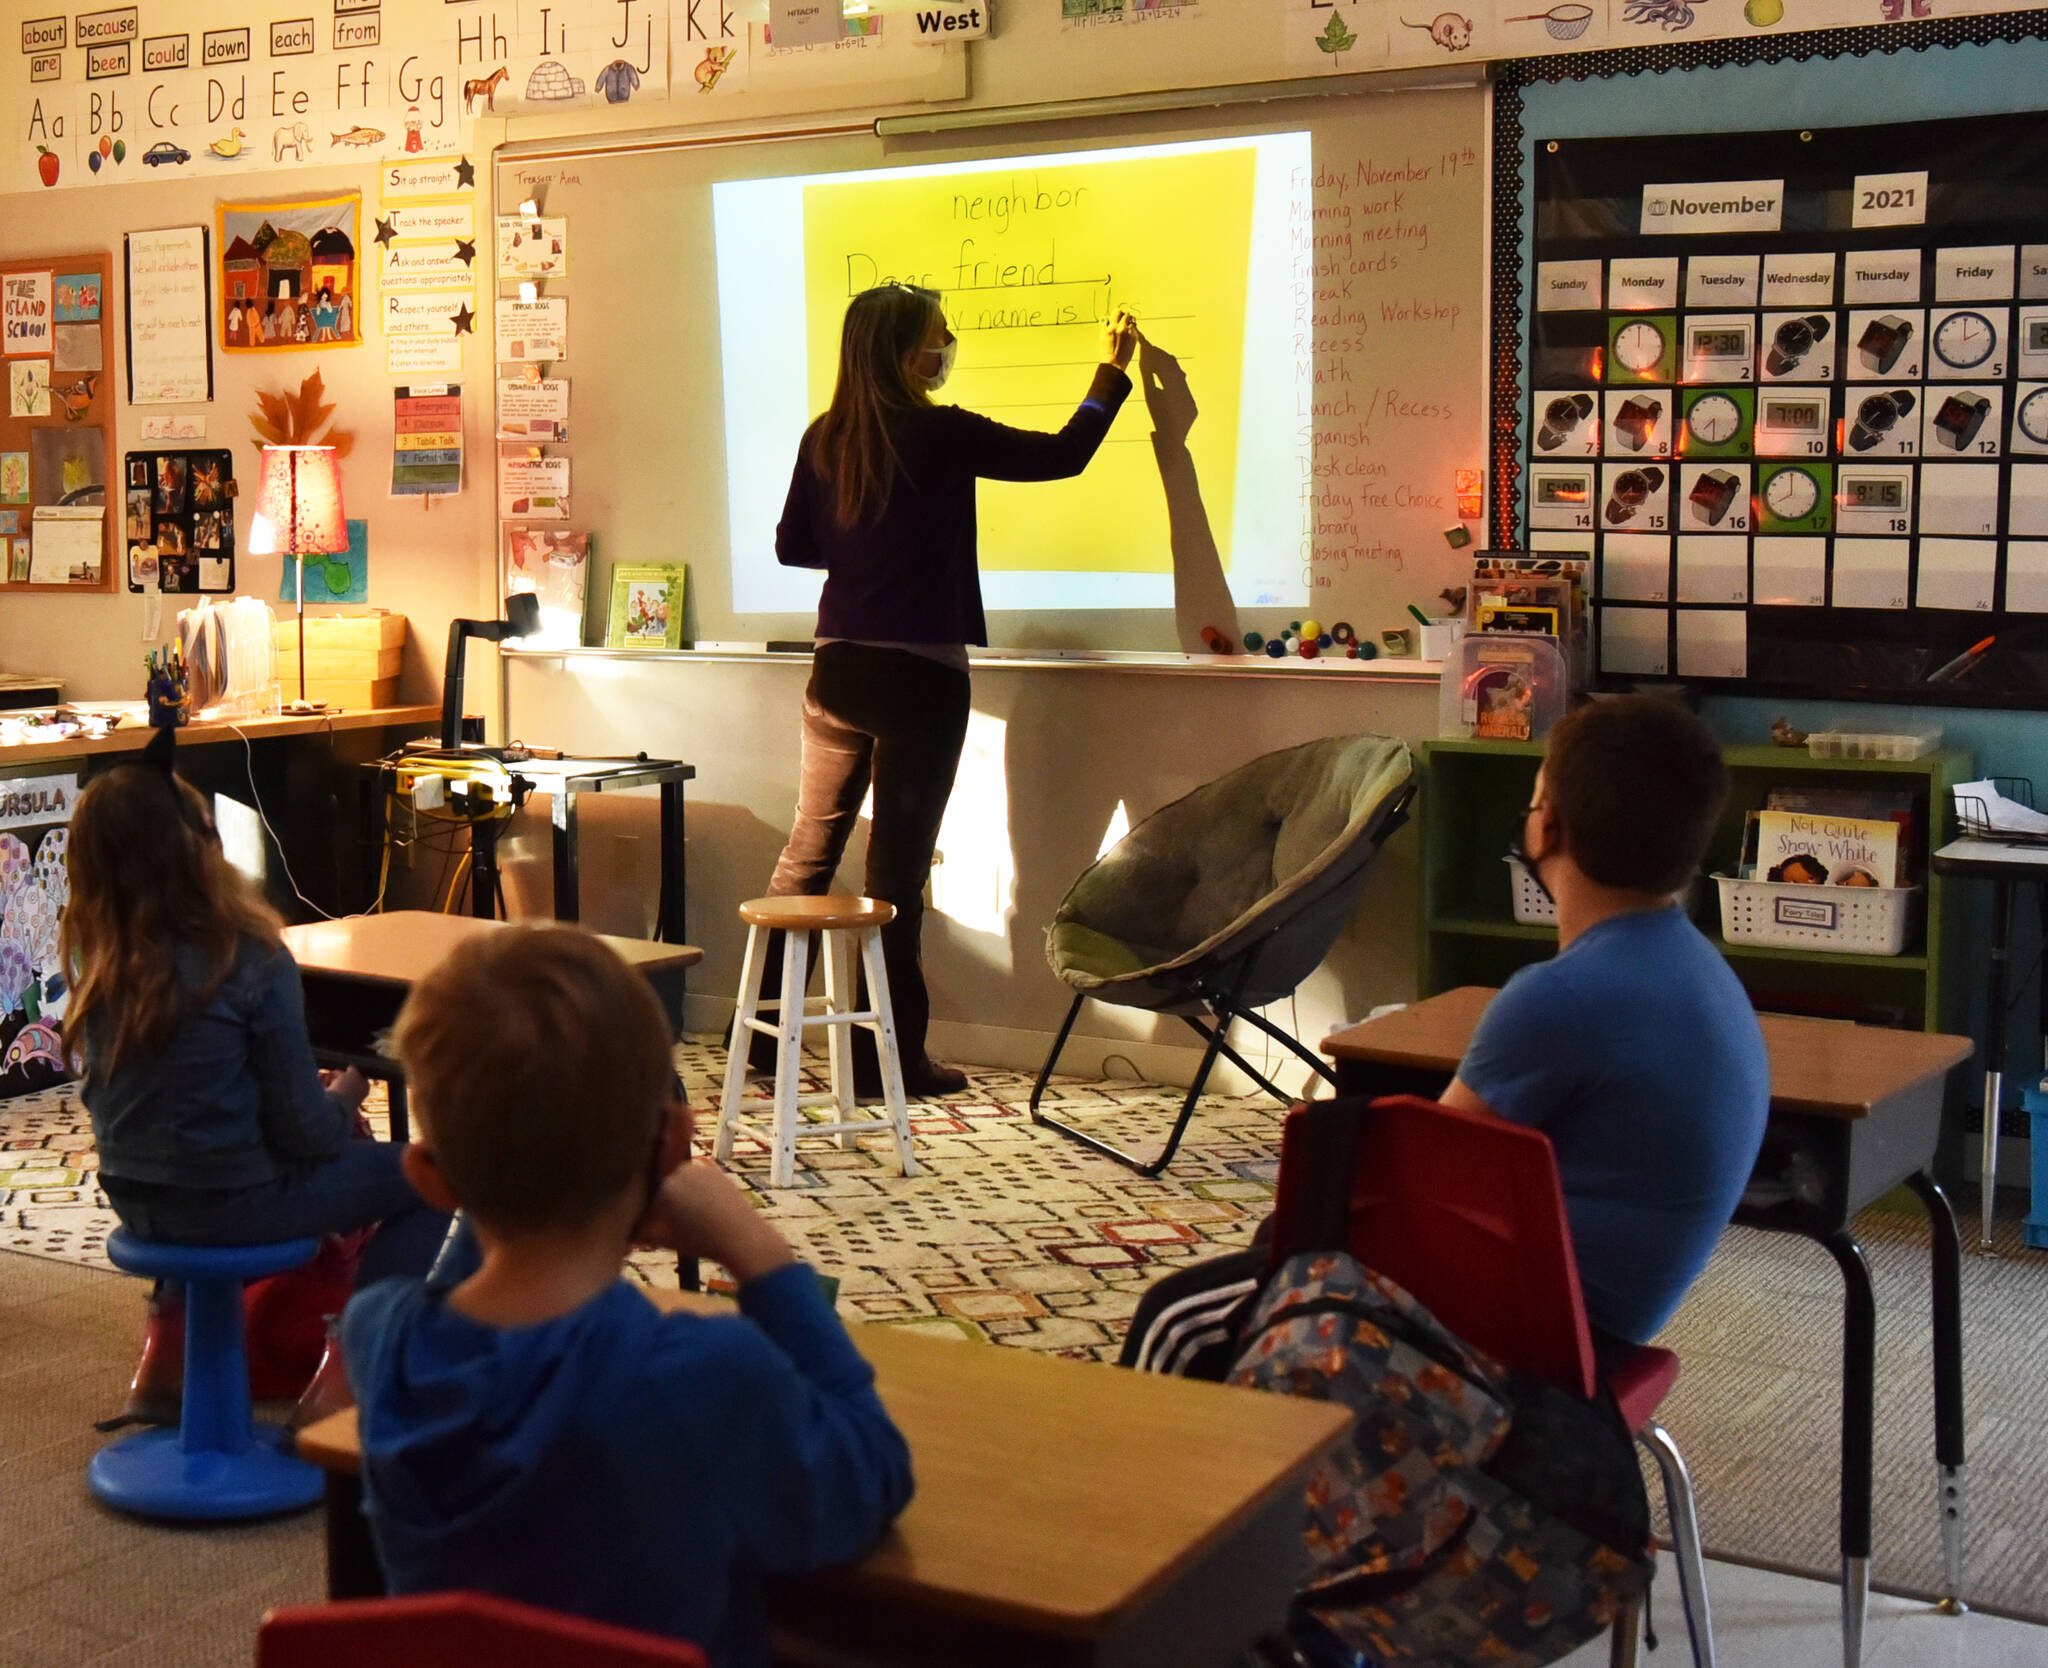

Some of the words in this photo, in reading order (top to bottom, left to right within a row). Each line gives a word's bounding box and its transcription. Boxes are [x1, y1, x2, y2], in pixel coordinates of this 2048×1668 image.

[787, 8, 819, 16] HITACHI
[79, 19, 135, 38] because
[917, 8, 980, 33] West
[25, 25, 63, 45] about
[275, 27, 311, 47] each
[337, 23, 376, 43] from
[148, 44, 185, 64] could
[208, 40, 245, 57] down
[34, 58, 57, 73] are
[91, 56, 125, 72] been
[390, 170, 406, 186] Sit
[409, 178, 417, 187] up
[1290, 163, 1350, 197] Friday,
[1357, 158, 1433, 187] November
[954, 172, 1088, 233] neighbor
[1670, 197, 1775, 216] November
[1862, 188, 1915, 209] 2021
[1288, 201, 1351, 228] Morning
[1364, 192, 1405, 214] work
[390, 211, 416, 227] Track
[419, 216, 431, 225] the
[1290, 228, 1352, 259] Morning
[1363, 223, 1428, 251] meeting
[390, 251, 408, 267] Ask
[411, 256, 424, 266] and
[1293, 255, 1339, 280] Finish
[1350, 255, 1399, 276] cards
[1856, 269, 1909, 282] Thursday
[1956, 267, 1993, 279] Friday
[2032, 265, 2048, 276] Sa
[382, 277, 416, 287] questions
[420, 272, 472, 285] appropriately
[1551, 279, 1588, 290] Sunday
[1622, 276, 1664, 288] Monday
[1700, 274, 1745, 286] Tuesday
[1767, 273, 1831, 285] Wednesday
[6, 280, 35, 299] THE
[1289, 280, 1352, 306] Break
[6, 299, 45, 316] ISLAND
[390, 298, 424, 316] Respect
[427, 303, 458, 315] yourself
[978, 307, 1042, 330] name
[1056, 301, 1078, 325] is
[1294, 306, 1367, 335] Reading
[1381, 300, 1461, 331] Workshop
[389, 323, 401, 331] and
[1293, 333, 1365, 355] Recess
[1295, 357, 1351, 385] Math
[1741, 368, 1749, 379] 2
[1821, 366, 1829, 377] 3
[1908, 365, 1918, 376] 4
[1993, 364, 2002, 375] 5
[1297, 392, 1356, 417] Lunch
[1385, 389, 1453, 419] Recess
[416, 437, 436, 446] Table
[439, 436, 455, 445] Talk
[1298, 423, 1370, 458] Spanish
[1585, 443, 1594, 454] 7
[1659, 442, 1667, 454] 8
[1739, 442, 1749, 453] 9
[1807, 441, 1823, 453] 10
[1898, 441, 1913, 454] 11
[1979, 441, 1996, 454] 12
[1296, 455, 1341, 477] Desk
[1345, 457, 1387, 477] clean
[1300, 481, 1352, 517] Friday
[1362, 482, 1390, 507] Free
[1394, 485, 1445, 510] Choice
[1575, 515, 1591, 527] 14
[1649, 516, 1664, 528] 15
[1729, 516, 1746, 529] 16
[1811, 517, 1827, 529] 17
[1889, 519, 1907, 531] 18
[1302, 514, 1358, 546] Library
[1301, 544, 1351, 572] Closing
[1354, 541, 1403, 572] meeting
[1651, 592, 1665, 600] 22
[1809, 596, 1823, 604] 24
[1891, 598, 1904, 608] 25
[1976, 600, 1988, 610] 26
[1730, 668, 1743, 677] 30
[1477, 725, 1530, 740] MINERALS
[1790, 818, 1817, 835] Not
[1824, 822, 1869, 841] Quite
[1778, 834, 1822, 855] Snow
[1829, 840, 1877, 864] White
